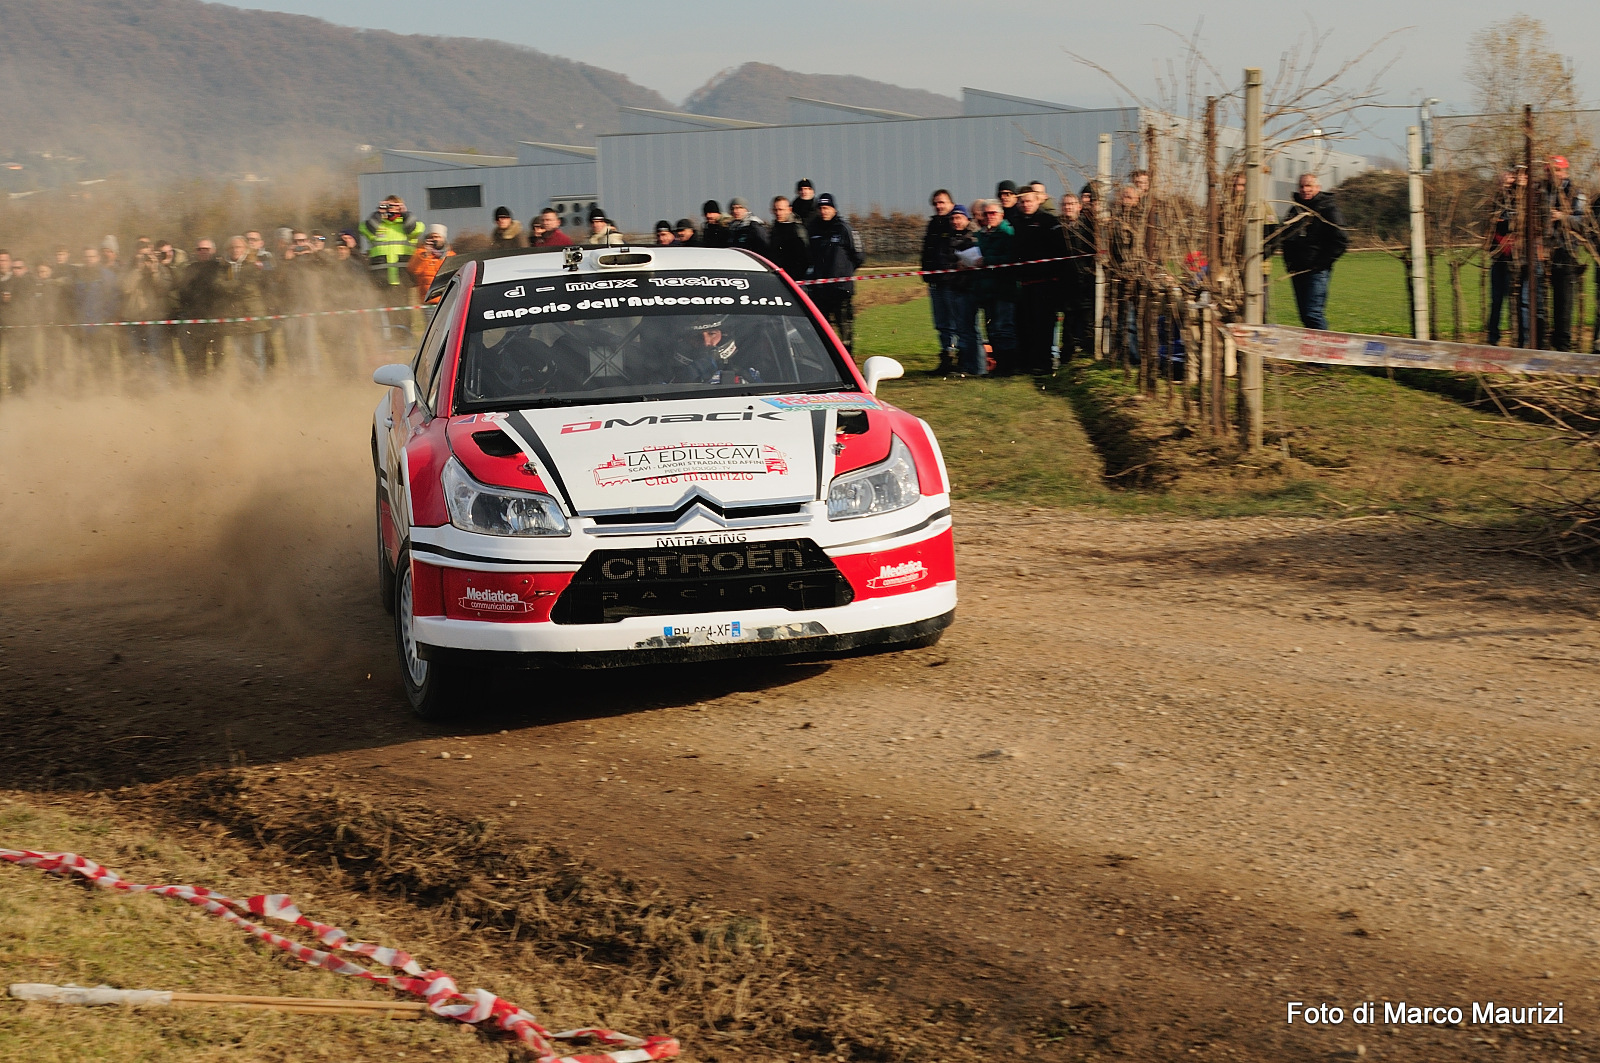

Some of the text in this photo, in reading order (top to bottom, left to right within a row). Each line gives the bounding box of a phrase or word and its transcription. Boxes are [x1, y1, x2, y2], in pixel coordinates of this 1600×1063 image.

[504, 285, 526, 298] d
[565, 278, 639, 292] max
[649, 276, 750, 290] racing
[483, 295, 793, 320] Emporio dell'Autocarro S.r.l.
[560, 411, 786, 434] DMACK
[628, 447, 760, 467] LA EDILSCAVI
[628, 465, 652, 473] SCAVI
[658, 461, 686, 469] LAVORI
[645, 476, 679, 486] Ciao
[880, 560, 922, 579] Mediatica
[466, 586, 519, 603] Mediatica
[471, 601, 515, 611] communication
